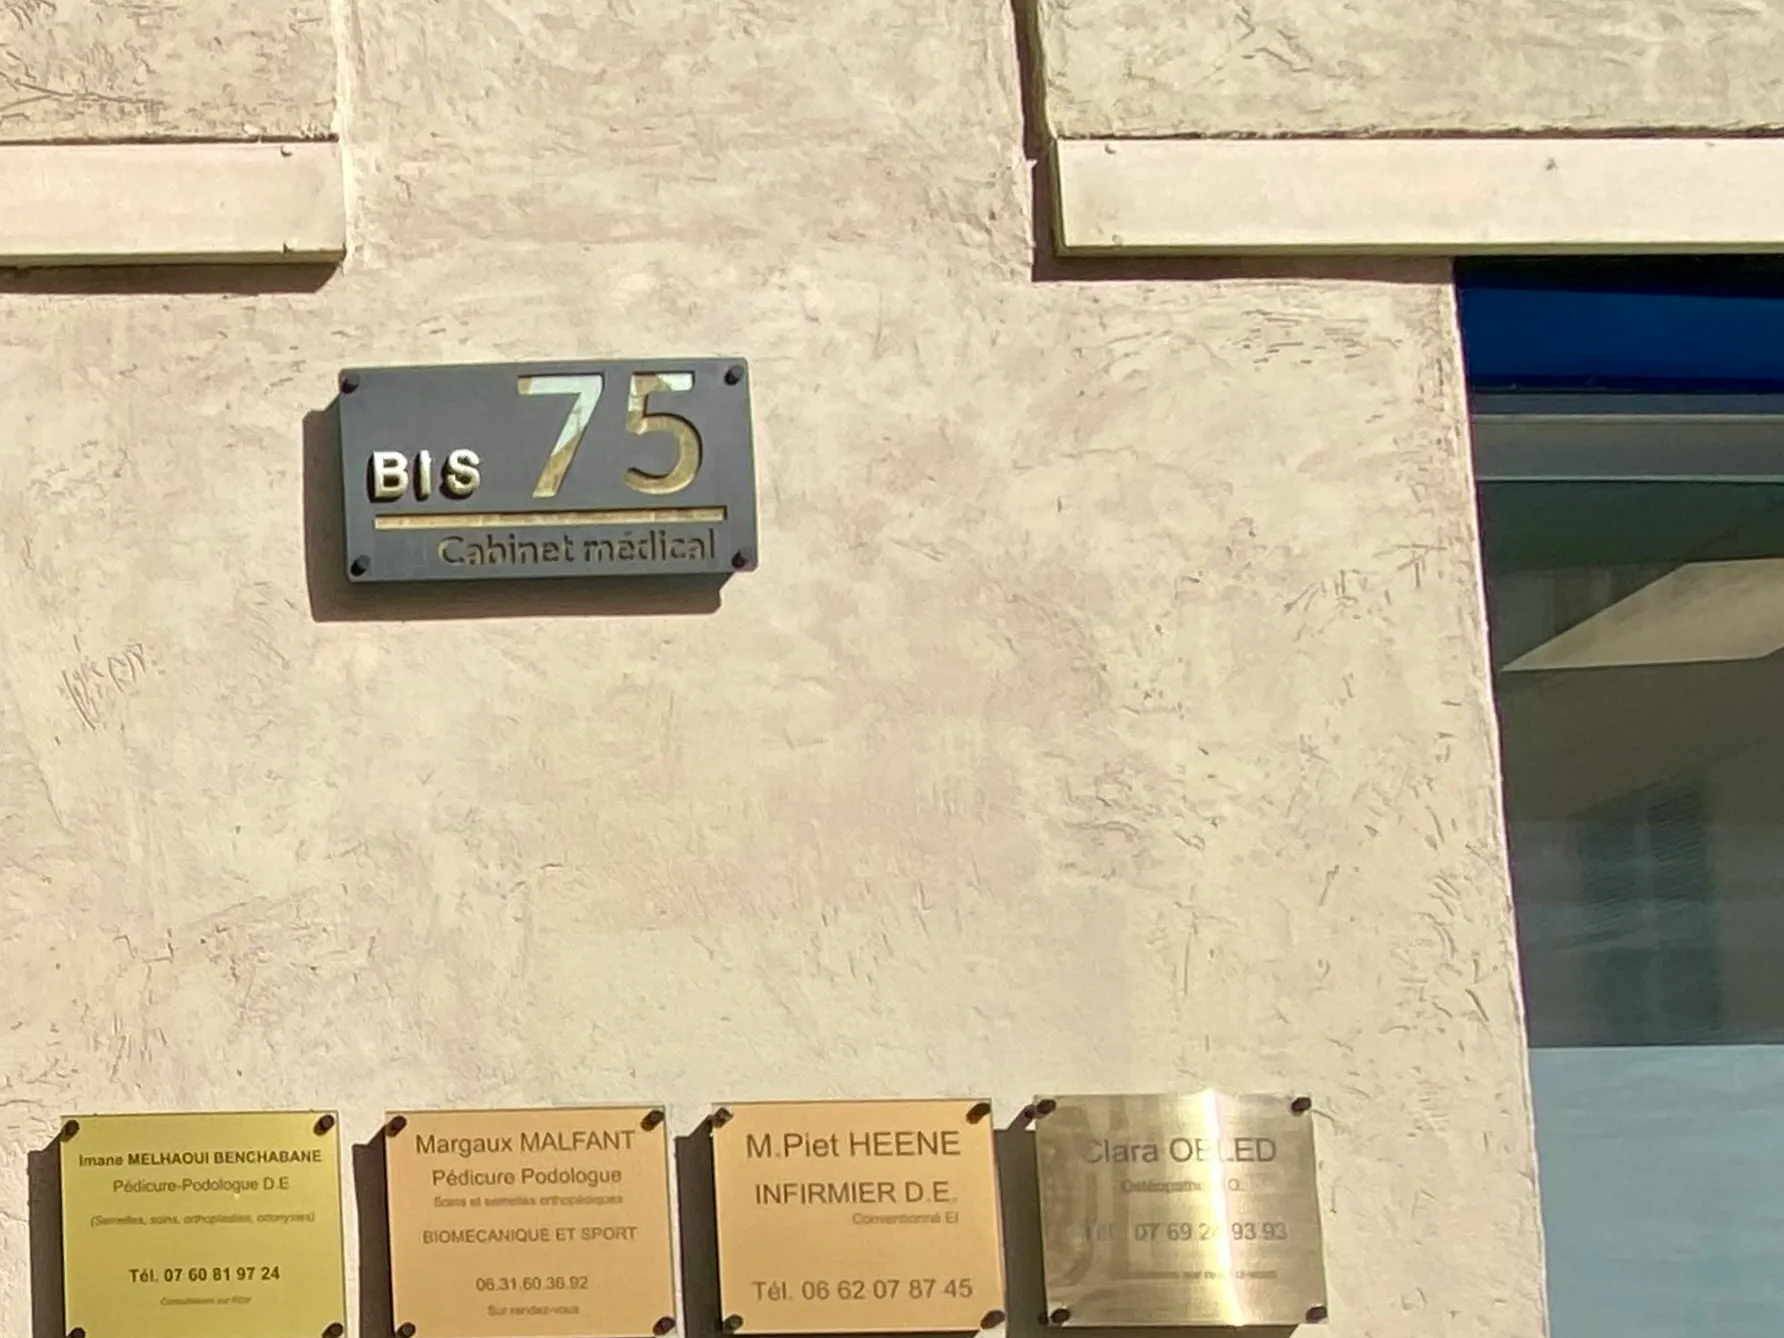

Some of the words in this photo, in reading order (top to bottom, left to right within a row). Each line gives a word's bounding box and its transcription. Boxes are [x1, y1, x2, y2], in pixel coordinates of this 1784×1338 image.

[368, 448, 482, 502] BIS
[517, 371, 703, 498] 75
[439, 533, 574, 566] Cabinet
[583, 529, 716, 561] médical
[416, 1133, 513, 1158] Margaux
[520, 1130, 636, 1151] MALFANT
[746, 1132, 840, 1159] M.Piet
[849, 1130, 961, 1157] HEENE
[1083, 1138, 1159, 1164] Clara
[79, 1154, 123, 1166] Imane
[128, 1151, 209, 1165] MELHAOUI
[214, 1149, 322, 1164] BENCHABANE
[113, 1177, 258, 1194] Pédicure-Podologue
[432, 1168, 515, 1186] Pédicure
[521, 1166, 622, 1188] Podologue
[755, 1181, 897, 1206] INFIRMIER
[905, 1181, 958, 1204] D.E.
[422, 1227, 550, 1244] BIOMECANIQUE
[556, 1227, 576, 1242] ET
[580, 1226, 638, 1241] SPORT
[1134, 1222, 1160, 1241] 07
[1167, 1222, 1192, 1241] 69
[1231, 1221, 1256, 1241] 93
[1262, 1222, 1288, 1241] 93
[129, 1268, 158, 1283] Tél.
[164, 1268, 183, 1282] 07
[188, 1268, 207, 1281] 60
[213, 1267, 231, 1281] 81
[236, 1266, 255, 1280] 97
[261, 1266, 280, 1280] 24
[752, 1280, 793, 1301] Tél.
[802, 1280, 830, 1300] 06
[837, 1279, 865, 1300] 62
[873, 1279, 900, 1300] 07
[908, 1278, 937, 1299] 87
[944, 1278, 974, 1299] 45
